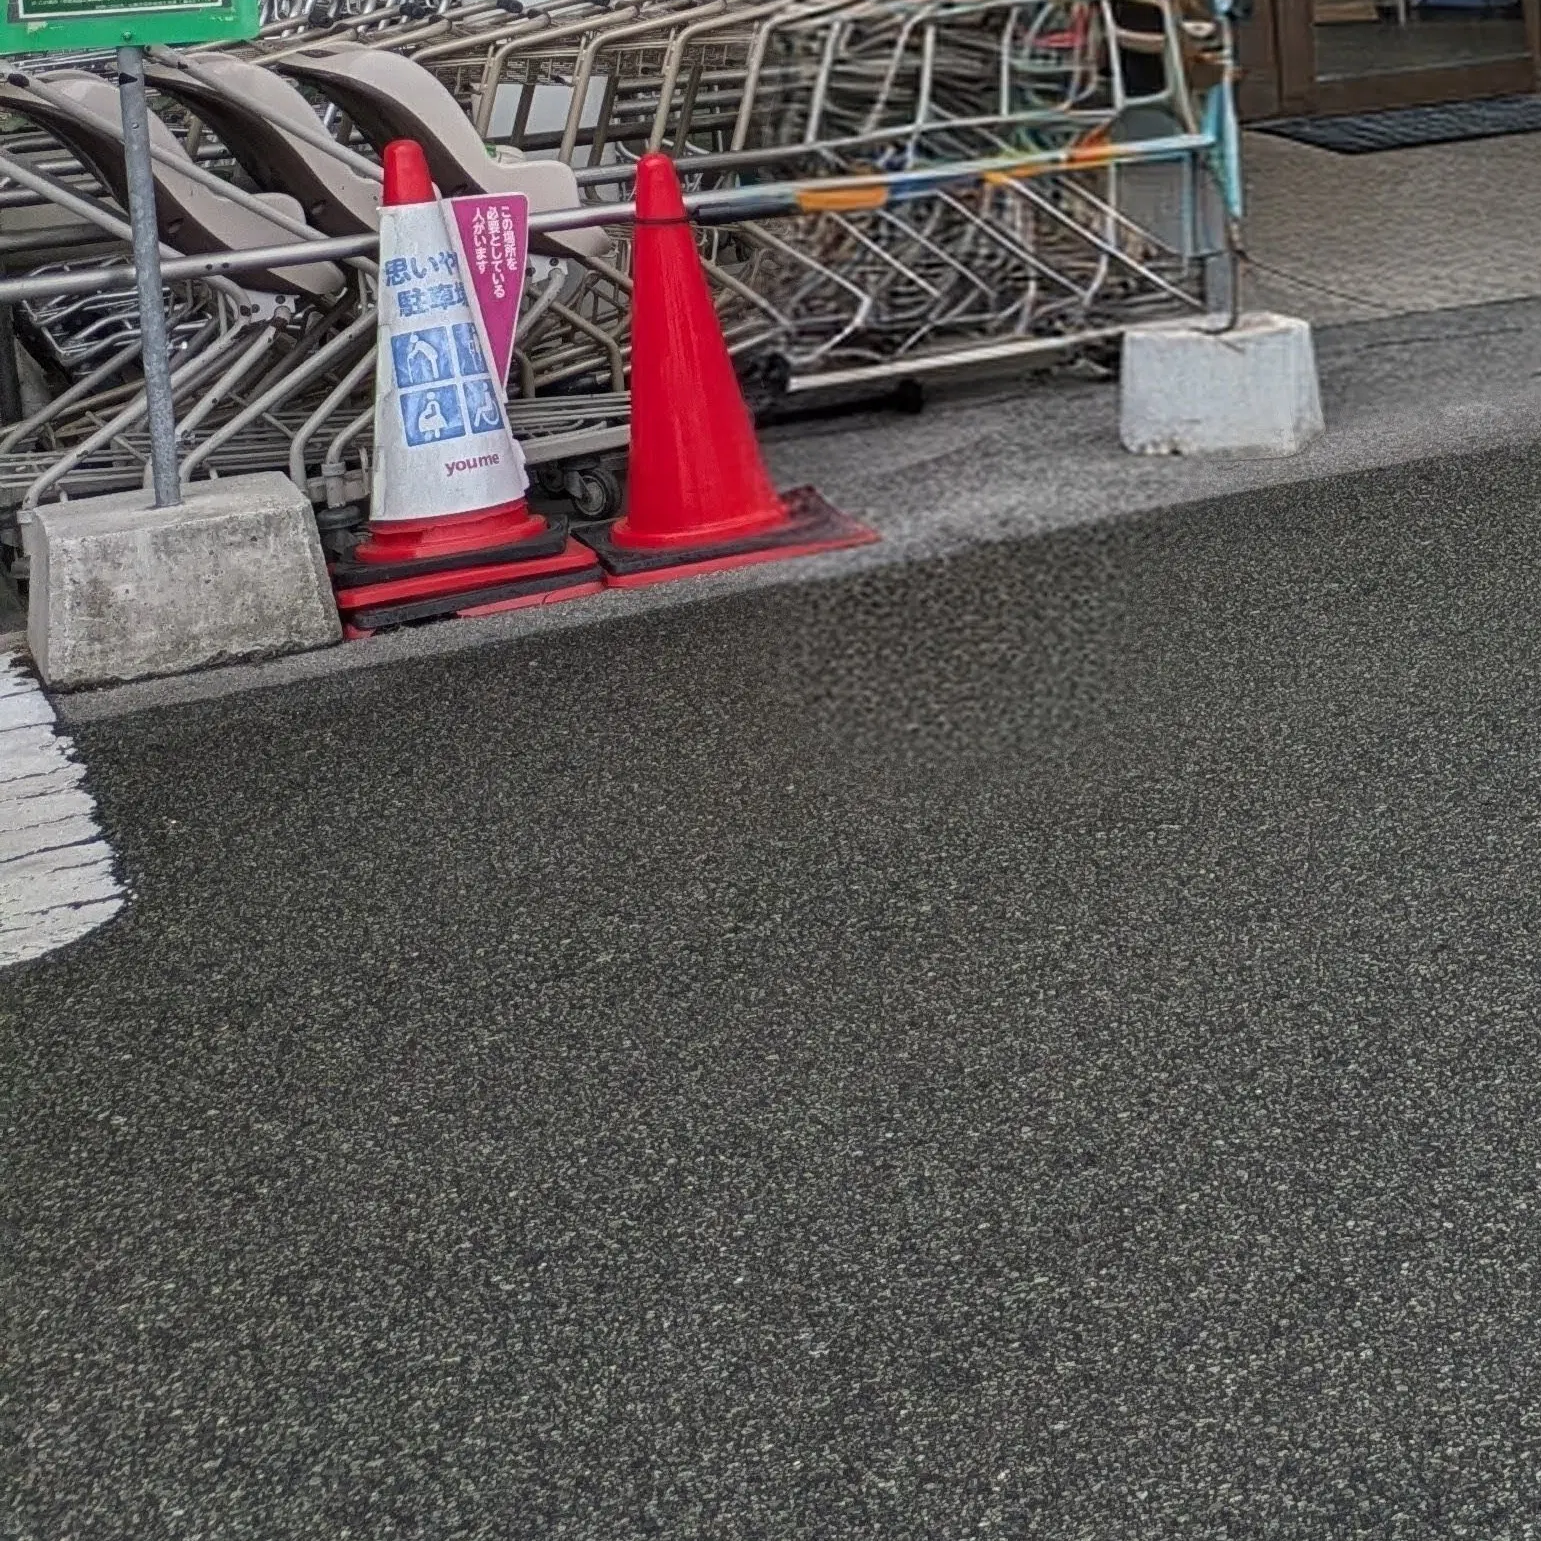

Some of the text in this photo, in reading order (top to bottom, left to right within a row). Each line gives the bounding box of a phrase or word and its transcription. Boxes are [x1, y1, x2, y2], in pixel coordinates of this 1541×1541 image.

[472, 207, 488, 275] 人がいます
[487, 206, 505, 298] 必要としている
[501, 206, 517, 271] この場所を
[445, 453, 500, 477] youme
